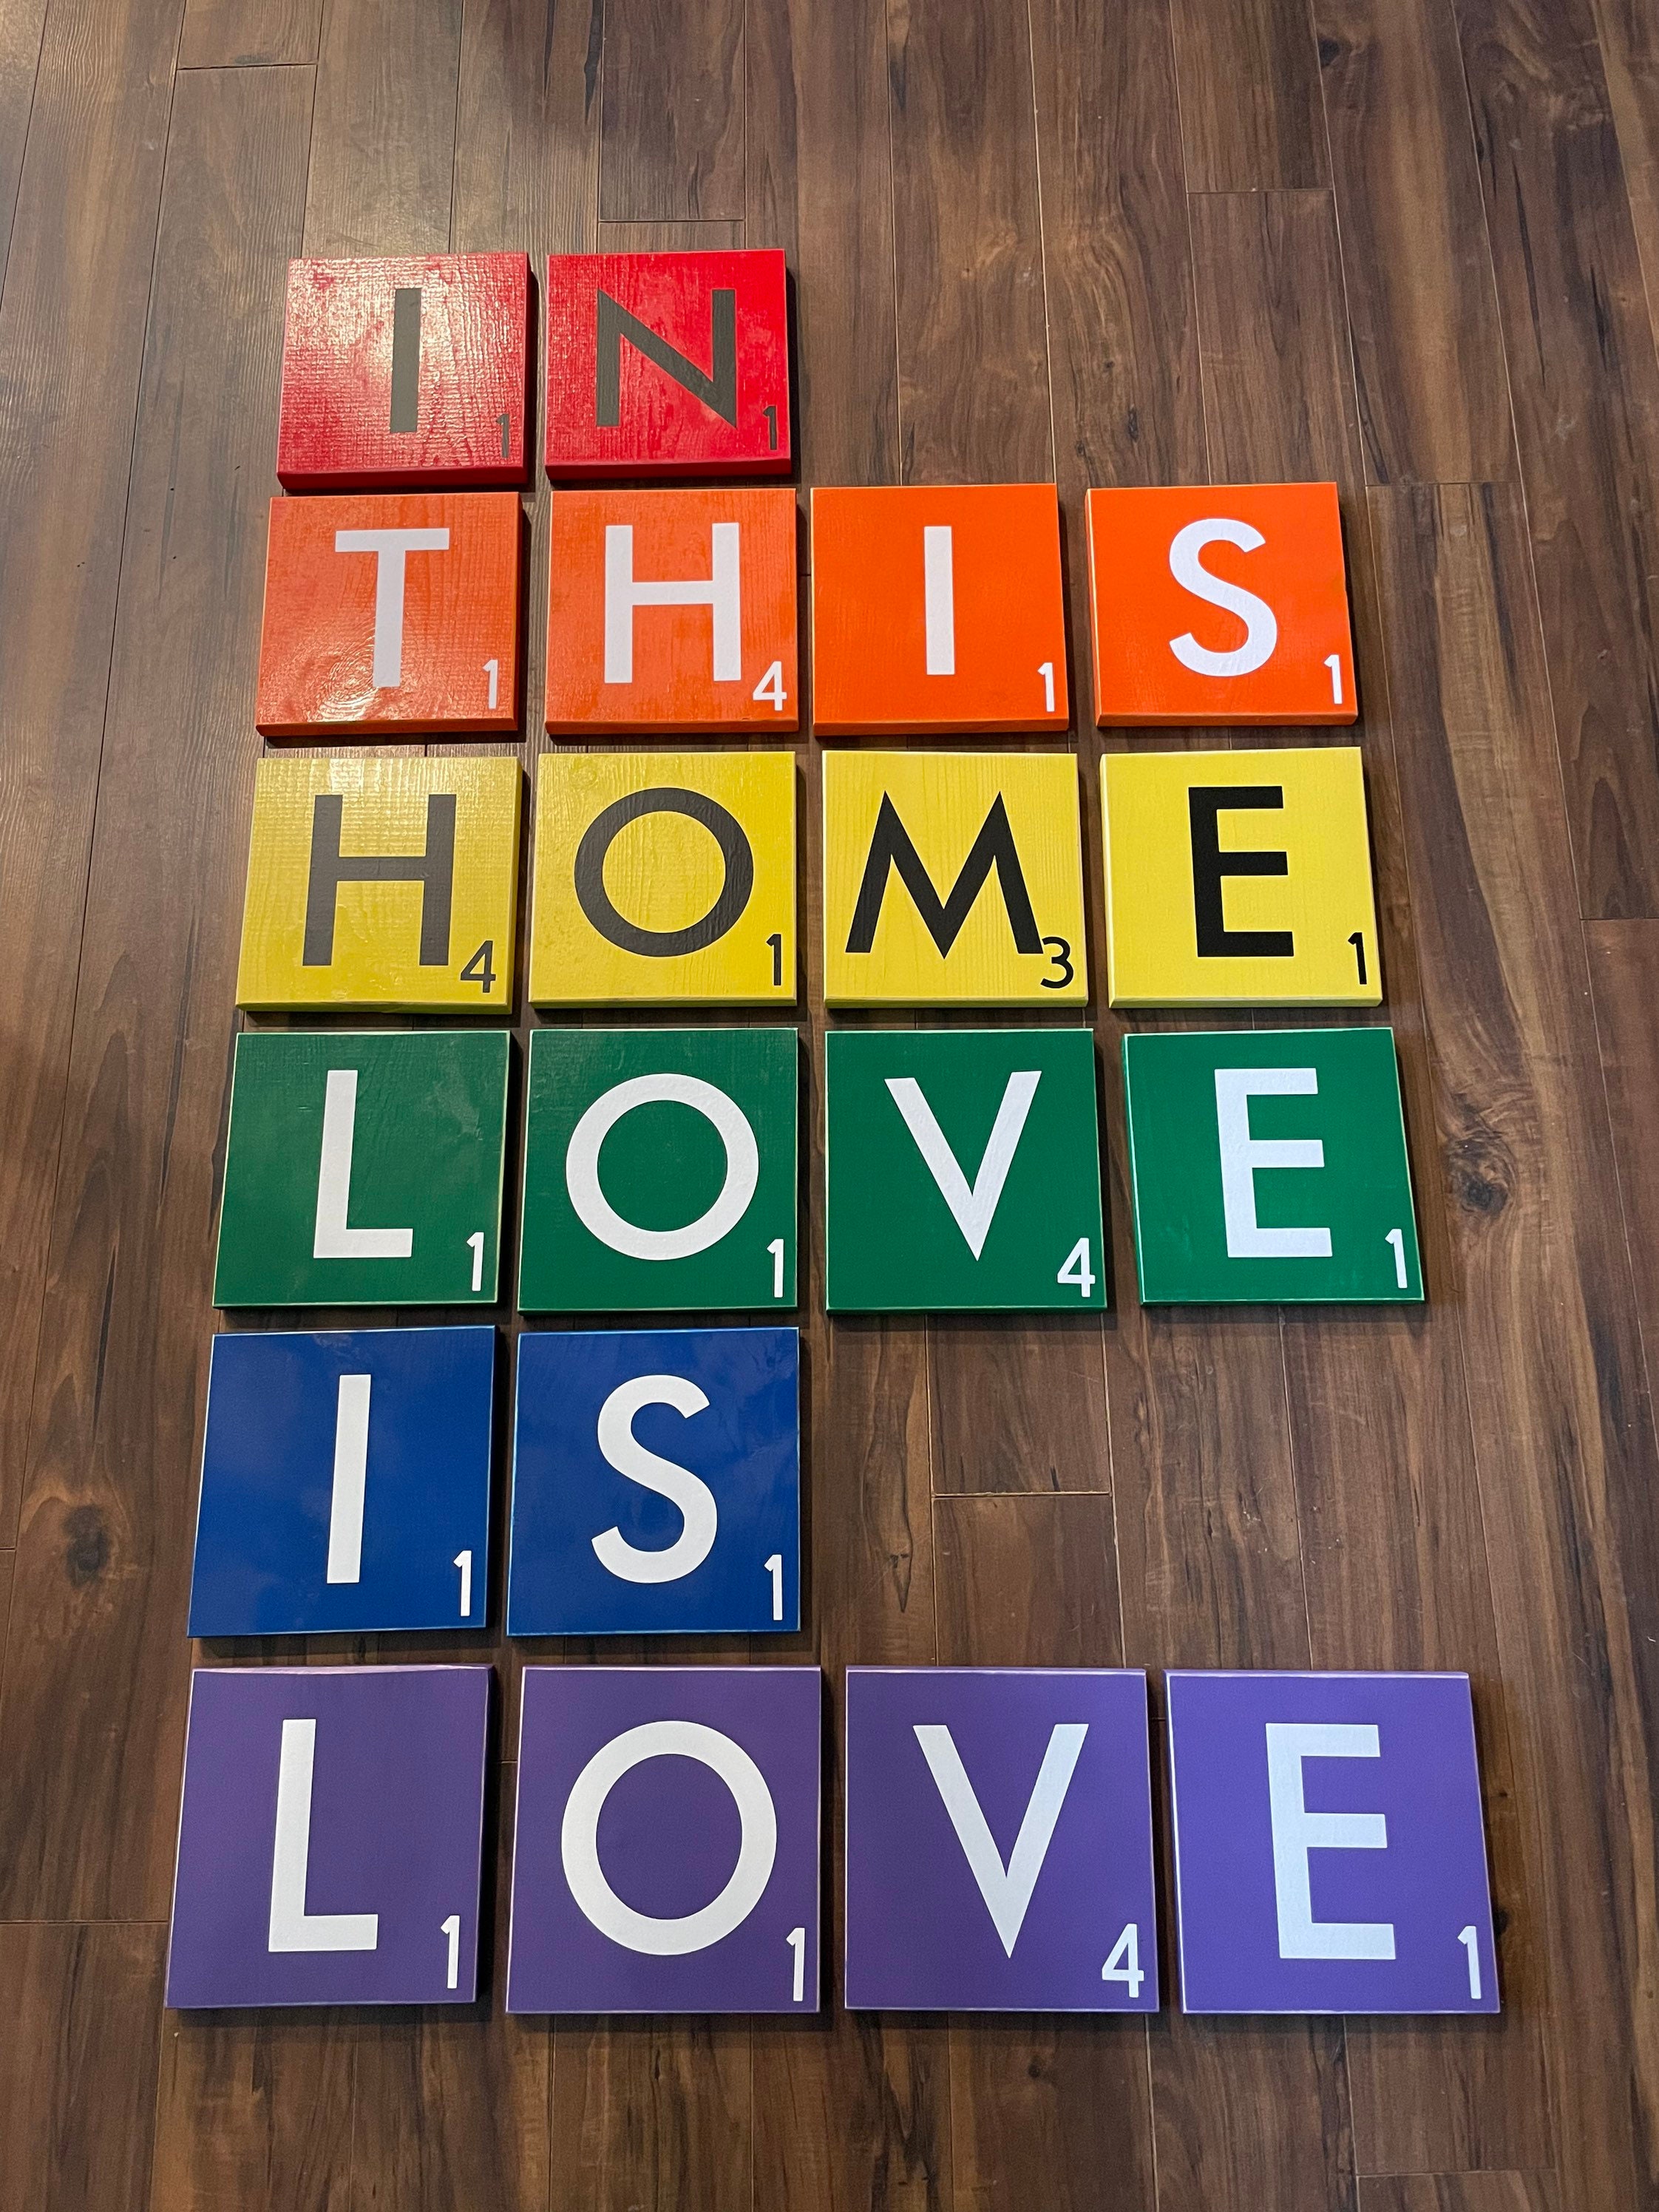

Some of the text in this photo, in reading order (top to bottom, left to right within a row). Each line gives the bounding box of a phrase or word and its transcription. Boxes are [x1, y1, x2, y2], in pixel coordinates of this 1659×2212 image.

[496, 413, 509, 458] 1
[763, 406, 778, 450] 1
[482, 659, 498, 710] 1
[753, 661, 787, 711] 4
[1037, 662, 1055, 712] 1
[1323, 654, 1343, 704] 1
[461, 940, 496, 994] 4
[765, 933, 782, 986] 1
[1040, 936, 1074, 988] 3
[1348, 932, 1367, 985] 1
[466, 1232, 484, 1292] 1
[766, 1238, 784, 1298] 1
[1057, 1237, 1096, 1297] 4
[1384, 1228, 1408, 1289] 1
[453, 1550, 473, 1617] 1
[764, 1553, 784, 1621] 1
[440, 1915, 461, 1989] 1
[786, 1927, 806, 2002] 1
[1102, 1923, 1144, 1998] 4
[1456, 1925, 1482, 2000] 1
